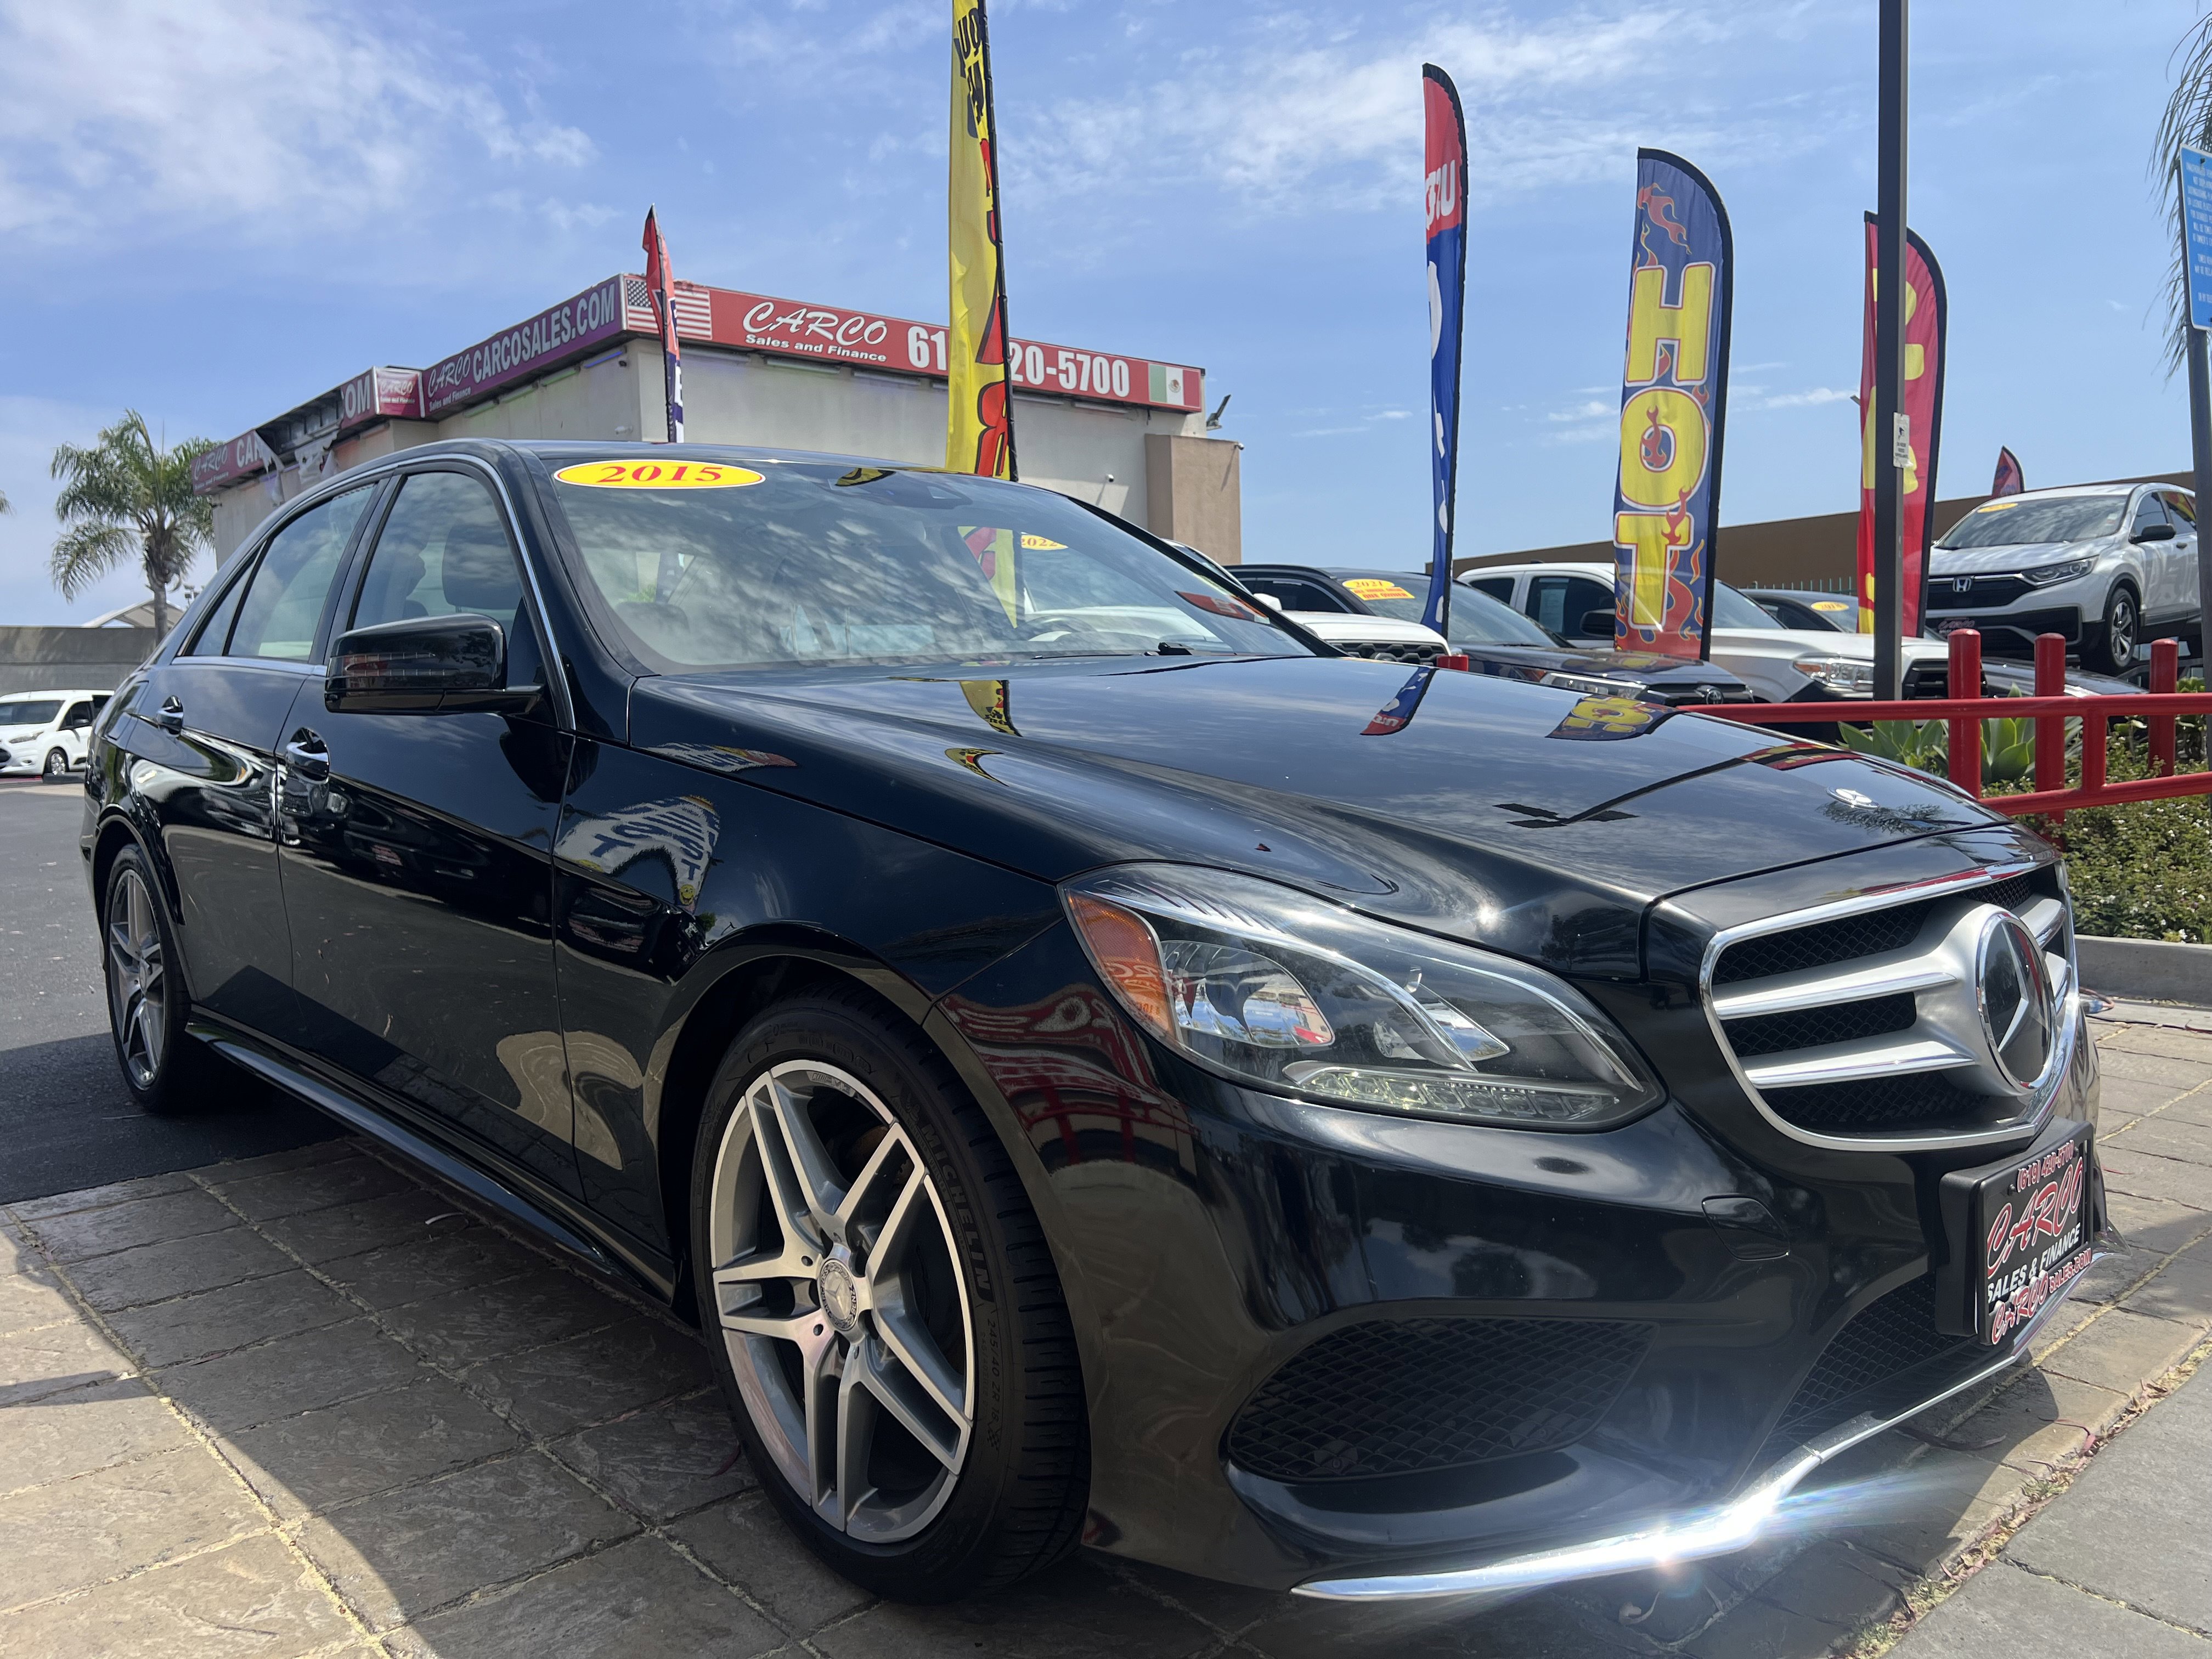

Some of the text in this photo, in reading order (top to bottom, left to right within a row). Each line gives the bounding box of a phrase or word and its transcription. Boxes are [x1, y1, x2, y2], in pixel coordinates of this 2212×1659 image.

[472, 283, 615, 384] CARCOSALES.COM
[742, 301, 887, 346] CARCO
[745, 334, 887, 362] Sales and Finance
[428, 353, 471, 398] CARCO
[597, 465, 725, 483] 2015
[2017, 1139, 2074, 1193] (619) 420-5700
[922, 1125, 991, 1289] MICHELIN
[1987, 1156, 2084, 1279] CARCO
[1987, 1222, 2081, 1304] SALES & FINANCE
